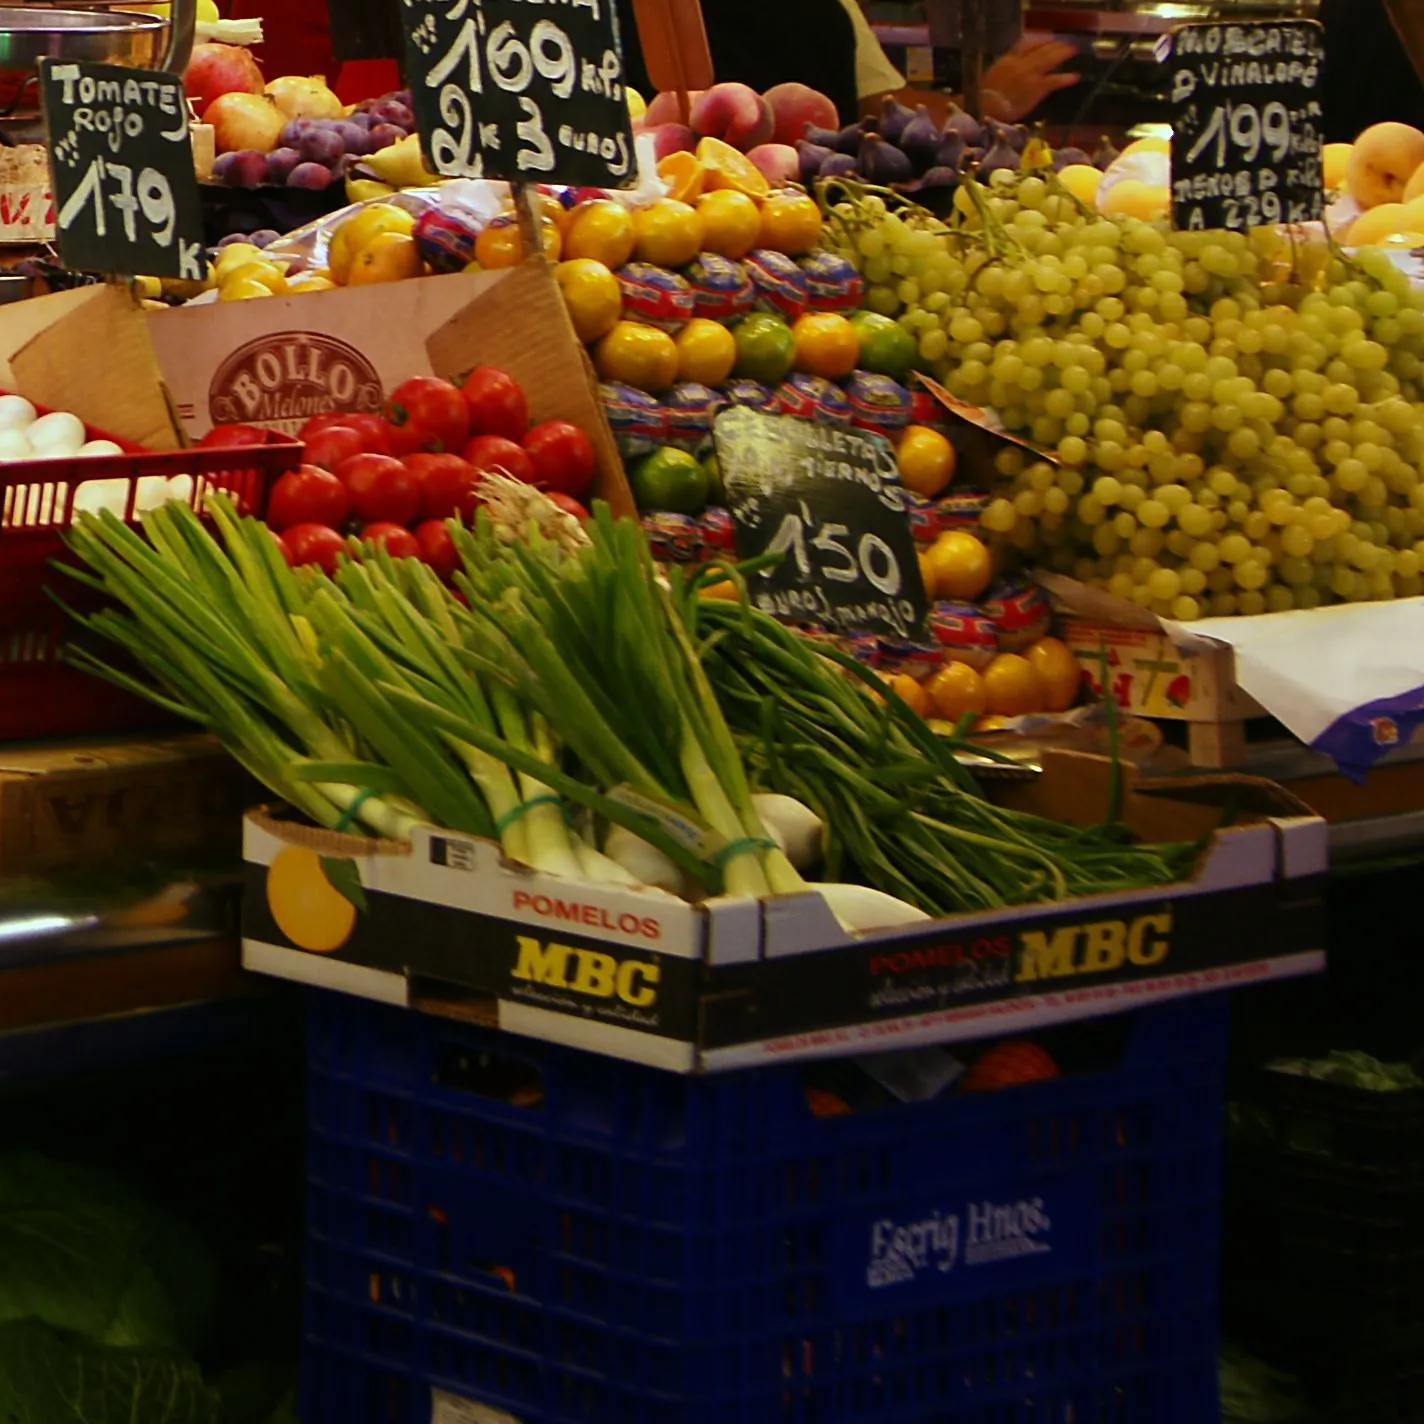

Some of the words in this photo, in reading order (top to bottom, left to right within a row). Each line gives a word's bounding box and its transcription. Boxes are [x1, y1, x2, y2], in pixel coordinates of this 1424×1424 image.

[515, 96, 556, 172] 3
[232, 344, 355, 411] BOLLO
[512, 889, 662, 941] POMELOS
[869, 933, 1012, 977] POMELOS
[1014, 912, 1174, 984] MBC
[510, 934, 660, 1008] MBC
